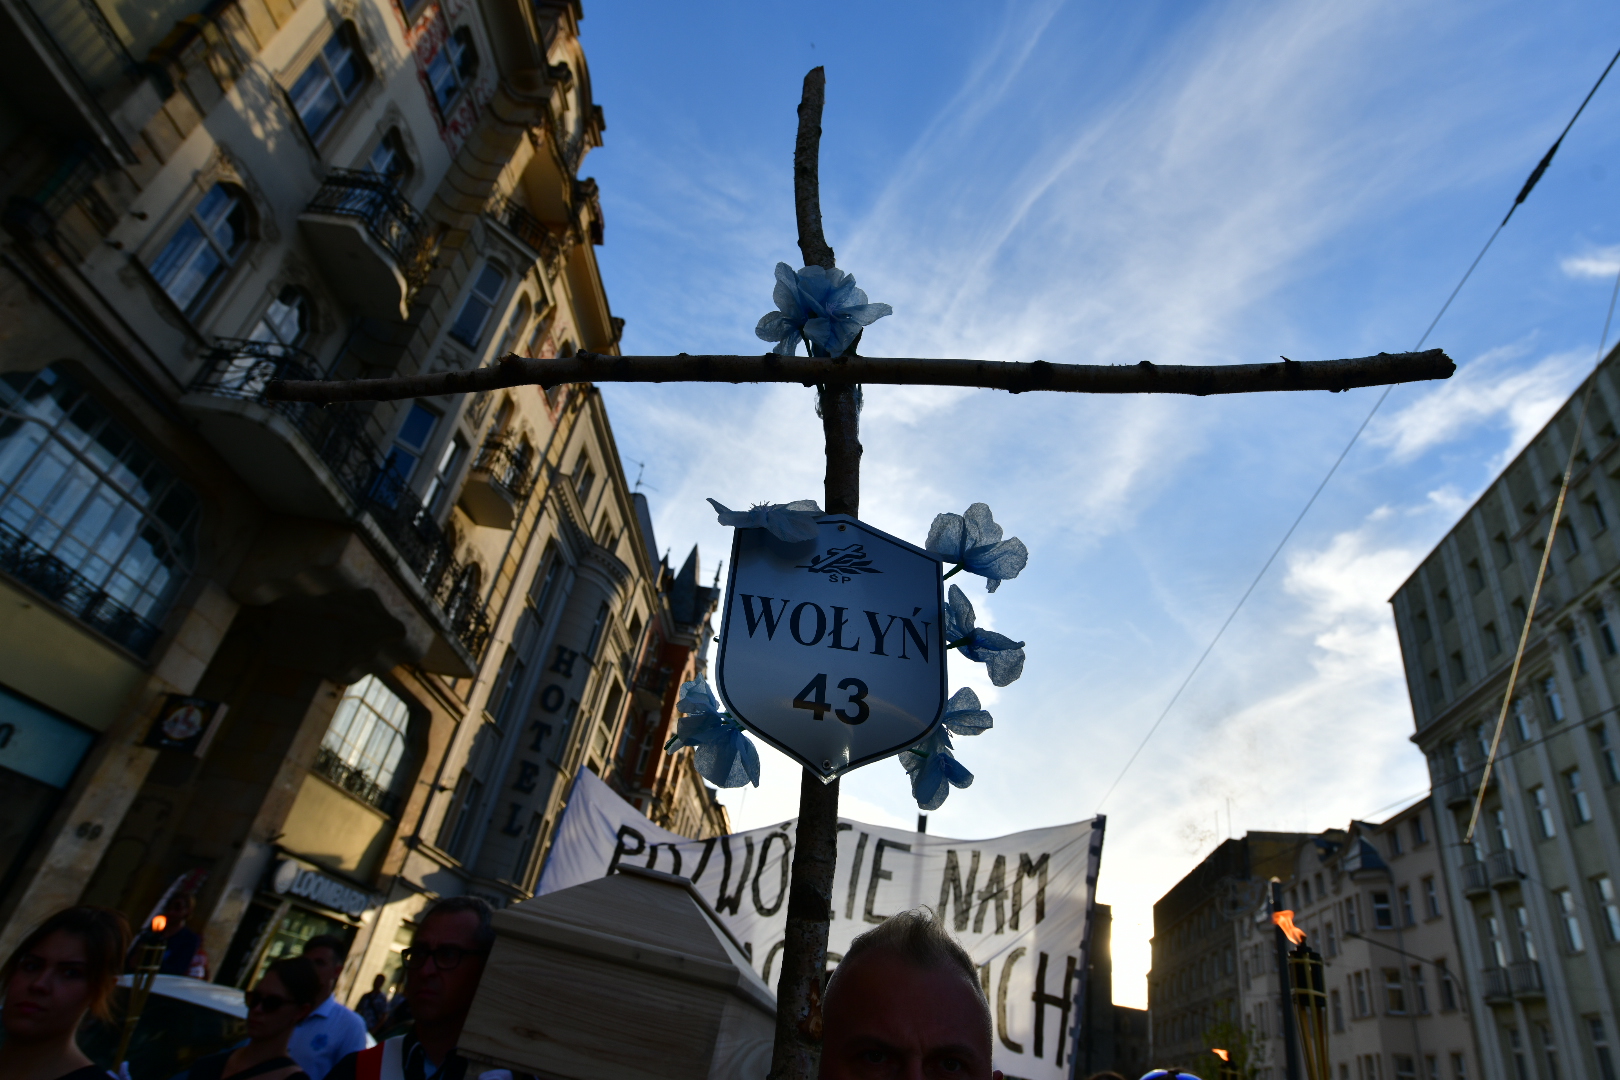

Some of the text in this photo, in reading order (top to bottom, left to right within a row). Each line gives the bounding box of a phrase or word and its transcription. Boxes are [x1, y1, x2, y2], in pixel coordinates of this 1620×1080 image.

[739, 593, 931, 664] WOŁYŃ
[793, 673, 870, 725] 43
[502, 644, 578, 837] HOTEL
[938, 849, 1050, 934] NAM
